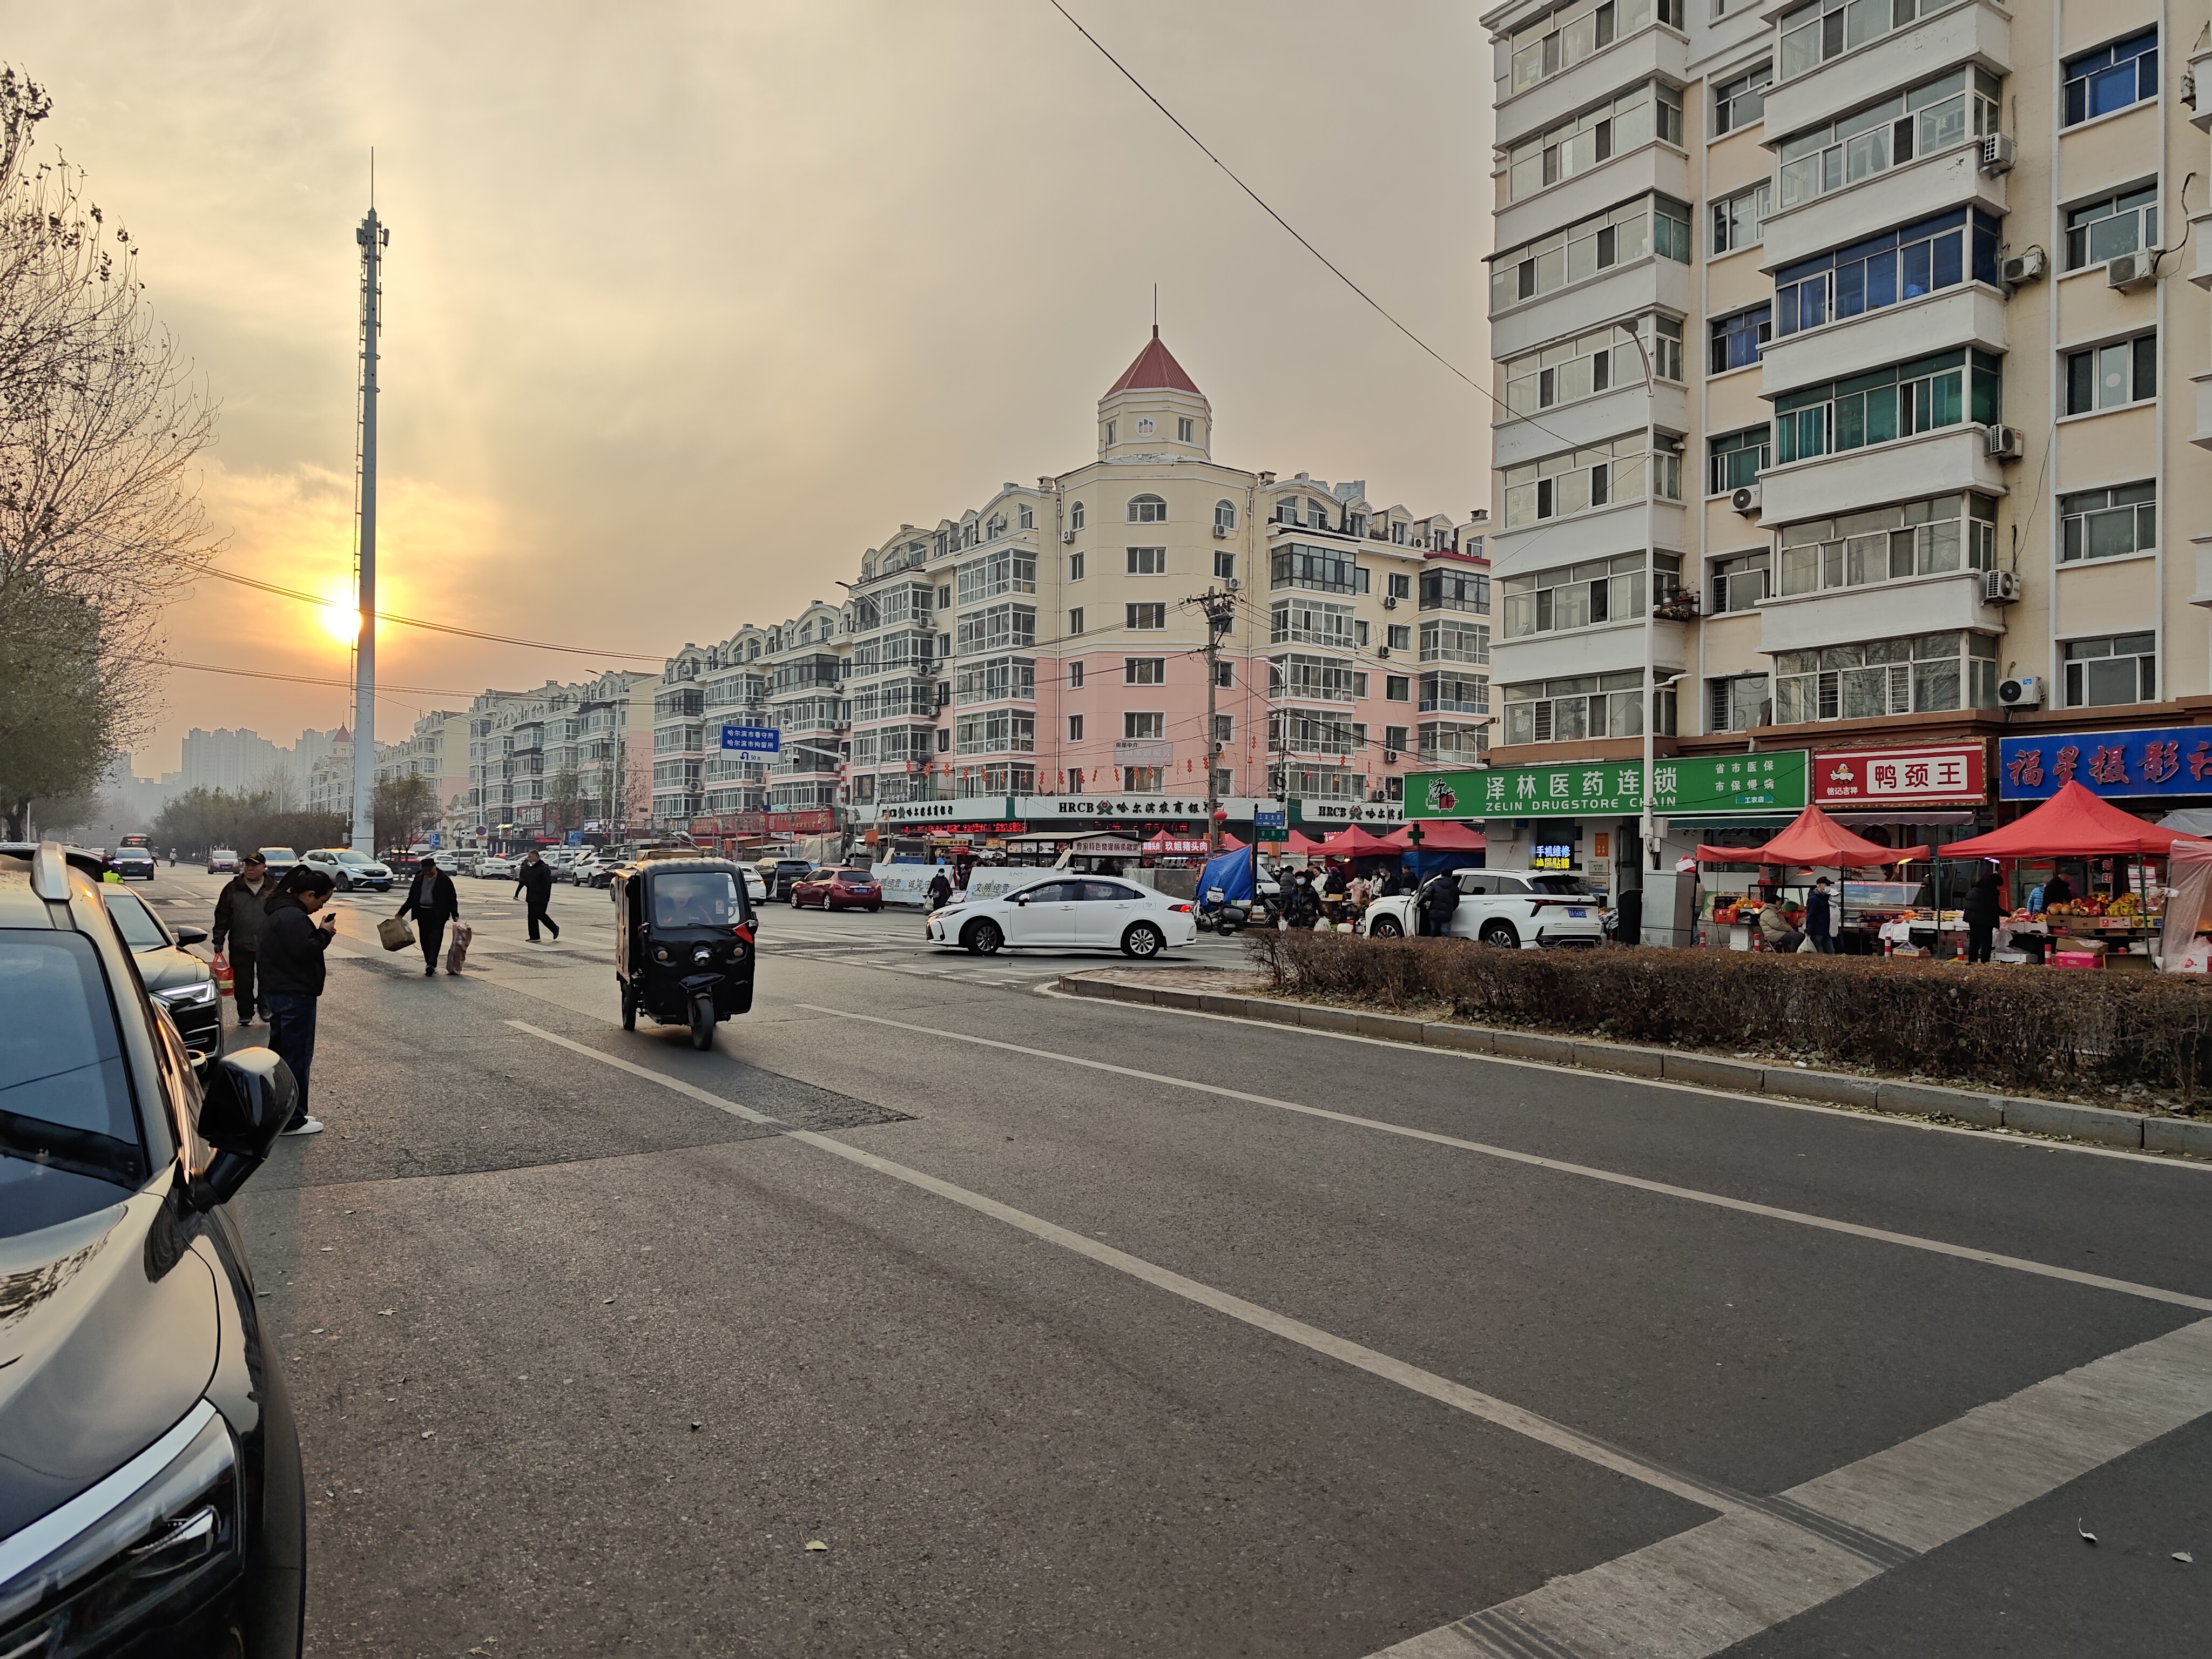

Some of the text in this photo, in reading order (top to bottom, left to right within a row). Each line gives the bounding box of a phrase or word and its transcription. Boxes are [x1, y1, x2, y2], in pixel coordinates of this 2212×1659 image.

[727, 730, 774, 739] 哈尔滨市看守所
[727, 739, 774, 749] 哈尔滨市拘留所
[1715, 760, 1774, 774] 省市医保
[1875, 762, 1961, 789] 鸭颈王
[1486, 767, 1677, 800] 泽林医药连锁
[1715, 778, 1774, 792] 市保慢病
[1826, 786, 1858, 795] 铭记吉祥
[1059, 802, 1094, 813] HRCB
[1486, 802, 1522, 812] ZELIN
[1532, 799, 1619, 810] DRUGSTORE
[1318, 806, 1346, 817] HRCB
[1143, 841, 1160, 851] 姐猪头肉
[1165, 841, 1208, 852] 玖姐猪头肉
[1536, 845, 1570, 858] 手机维修
[974, 882, 1010, 894] 文明经营
